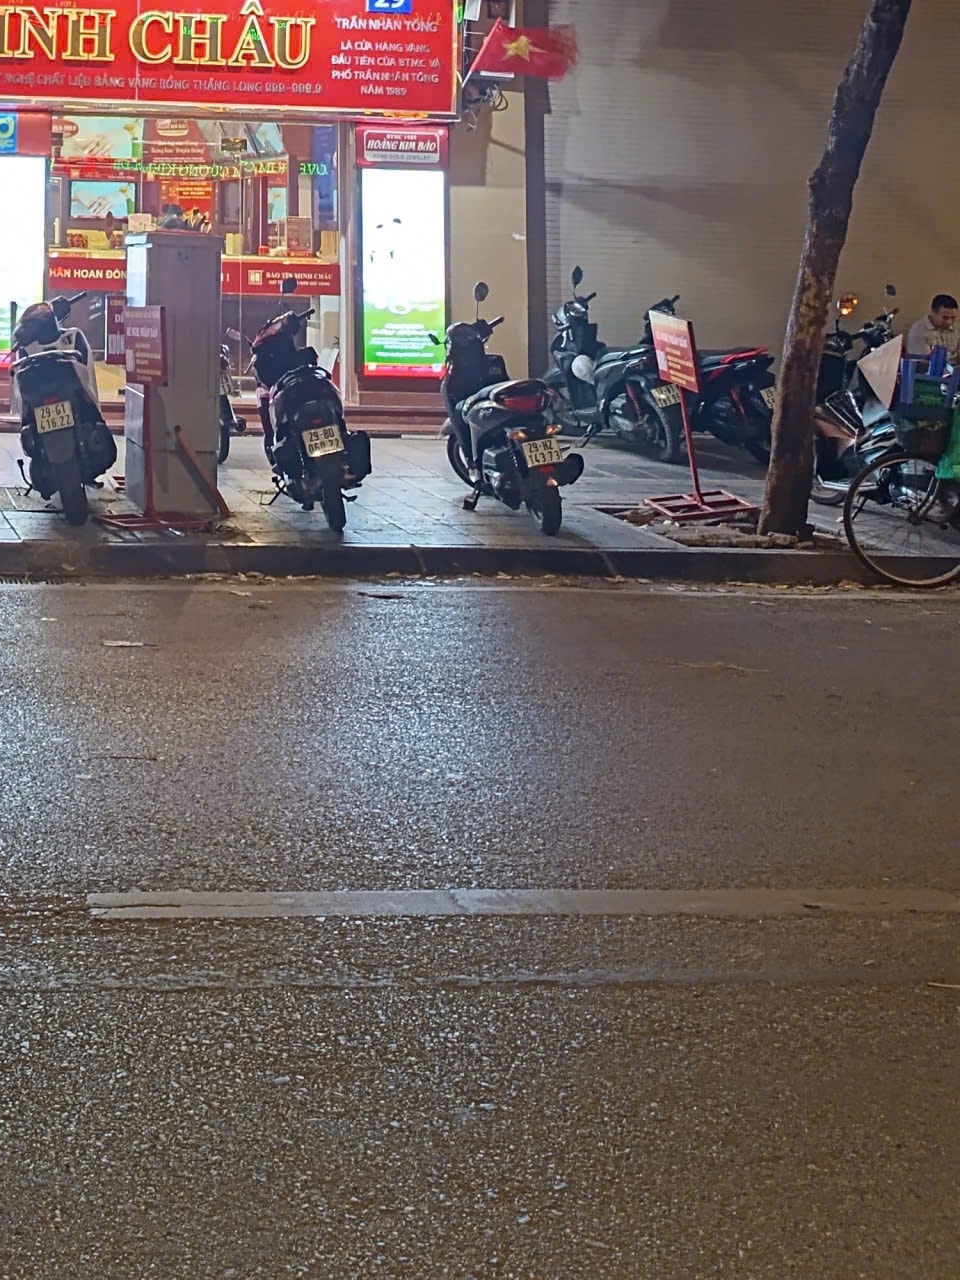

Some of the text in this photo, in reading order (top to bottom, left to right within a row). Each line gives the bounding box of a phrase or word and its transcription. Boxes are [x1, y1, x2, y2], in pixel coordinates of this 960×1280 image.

[398, 141, 416, 151] KIM
[73, 268, 103, 279] HOAN
[527, 439, 555, 454] 29-H2
